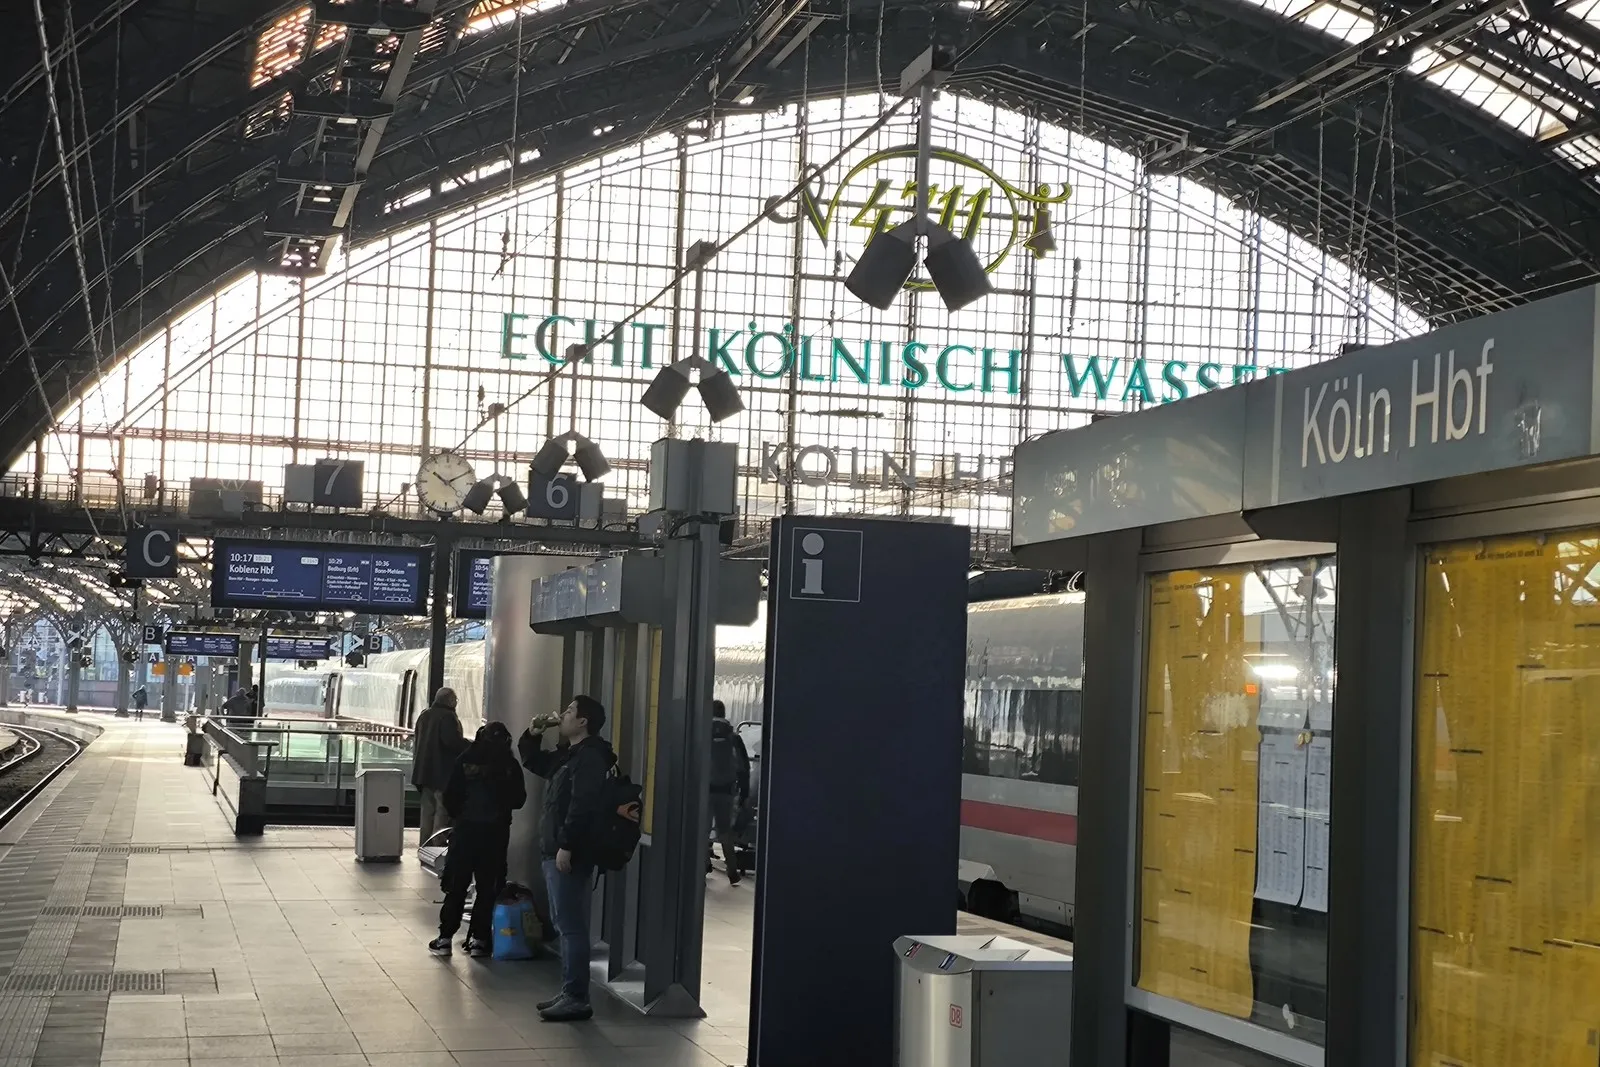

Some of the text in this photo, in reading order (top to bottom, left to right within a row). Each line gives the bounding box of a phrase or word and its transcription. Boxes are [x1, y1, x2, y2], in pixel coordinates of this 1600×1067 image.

[501, 313, 1290, 403] ECHT KÖLNISCH WASS
[1300, 338, 1495, 469] Köln Hbf
[323, 459, 346, 495] 7
[760, 440, 917, 491] KÖLN
[546, 473, 569, 508] 6
[142, 530, 171, 568] C
[230, 553, 253, 562] 10:17
[229, 564, 275, 575] Koblenz Hbf
[145, 627, 155, 641] B
[369, 636, 380, 650] B
[951, 1006, 962, 1026] DB
